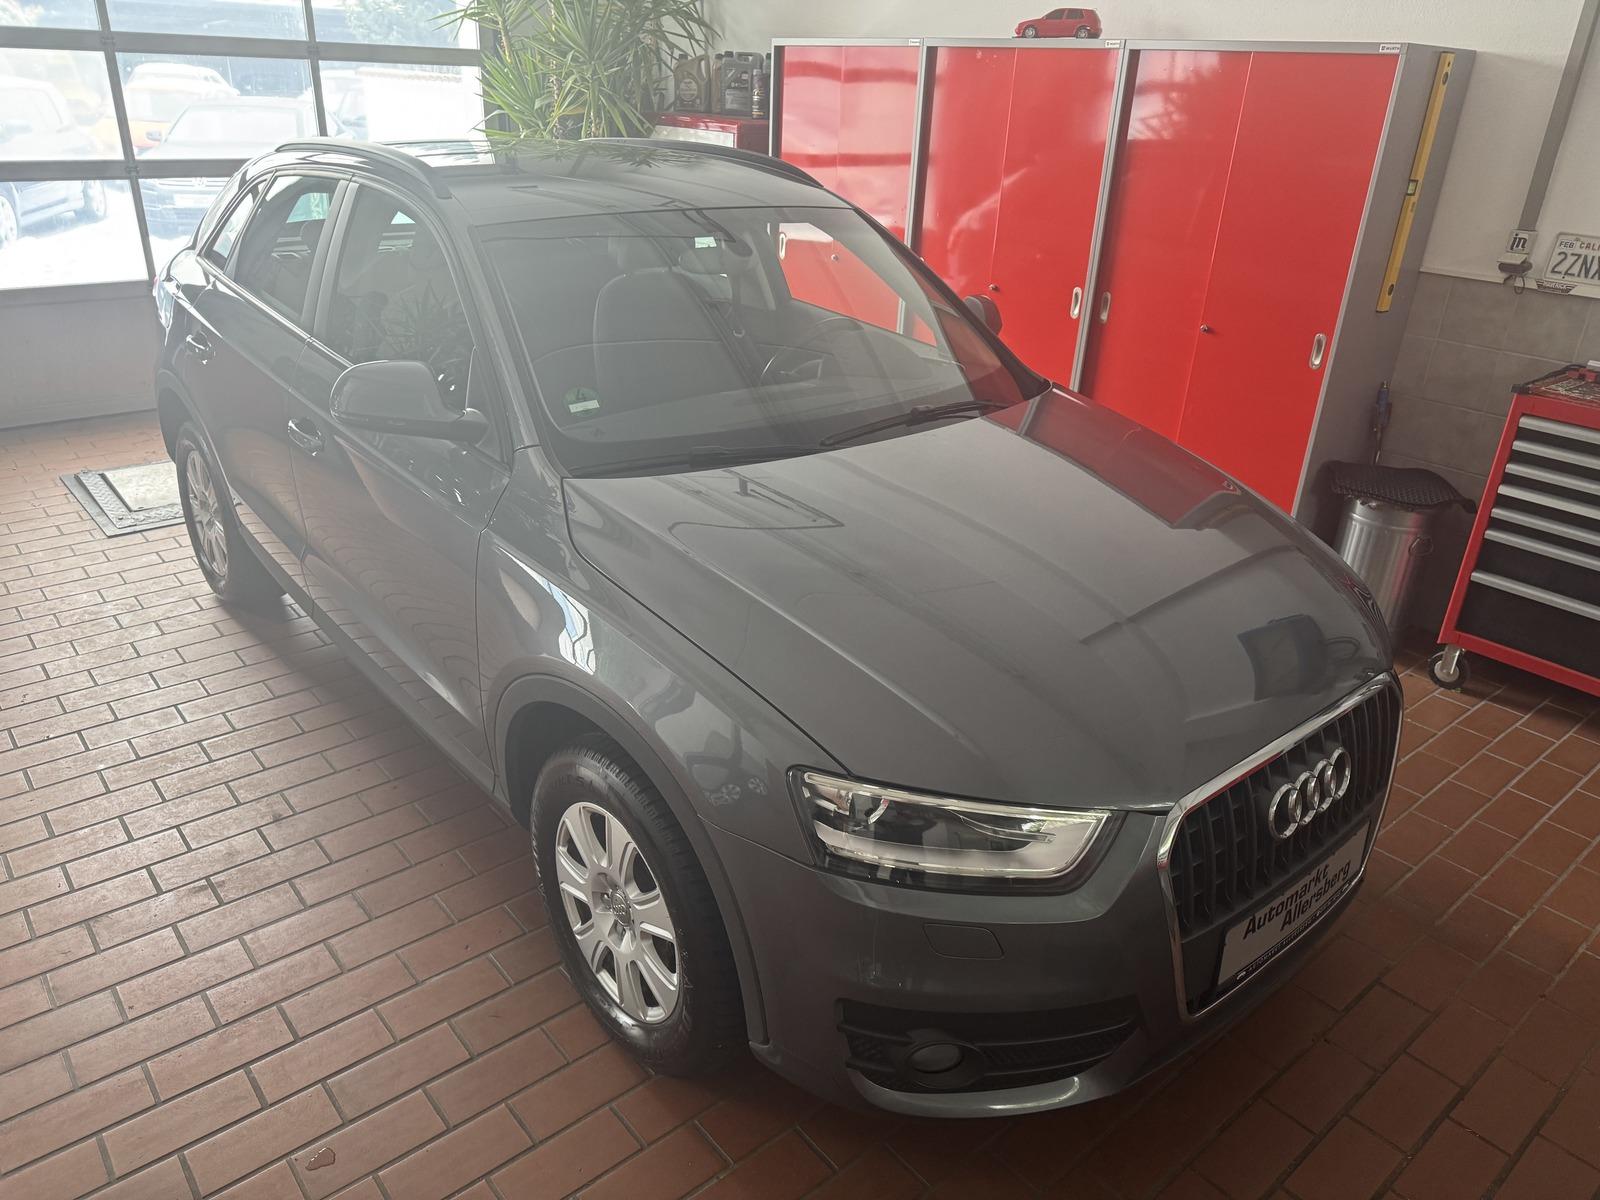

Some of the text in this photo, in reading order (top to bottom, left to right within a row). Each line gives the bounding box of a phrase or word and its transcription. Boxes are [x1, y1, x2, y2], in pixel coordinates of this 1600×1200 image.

[1559, 241, 1574, 249] FEB
[1242, 865, 1329, 940] Automarkt
[1280, 860, 1351, 932] Allersberg
